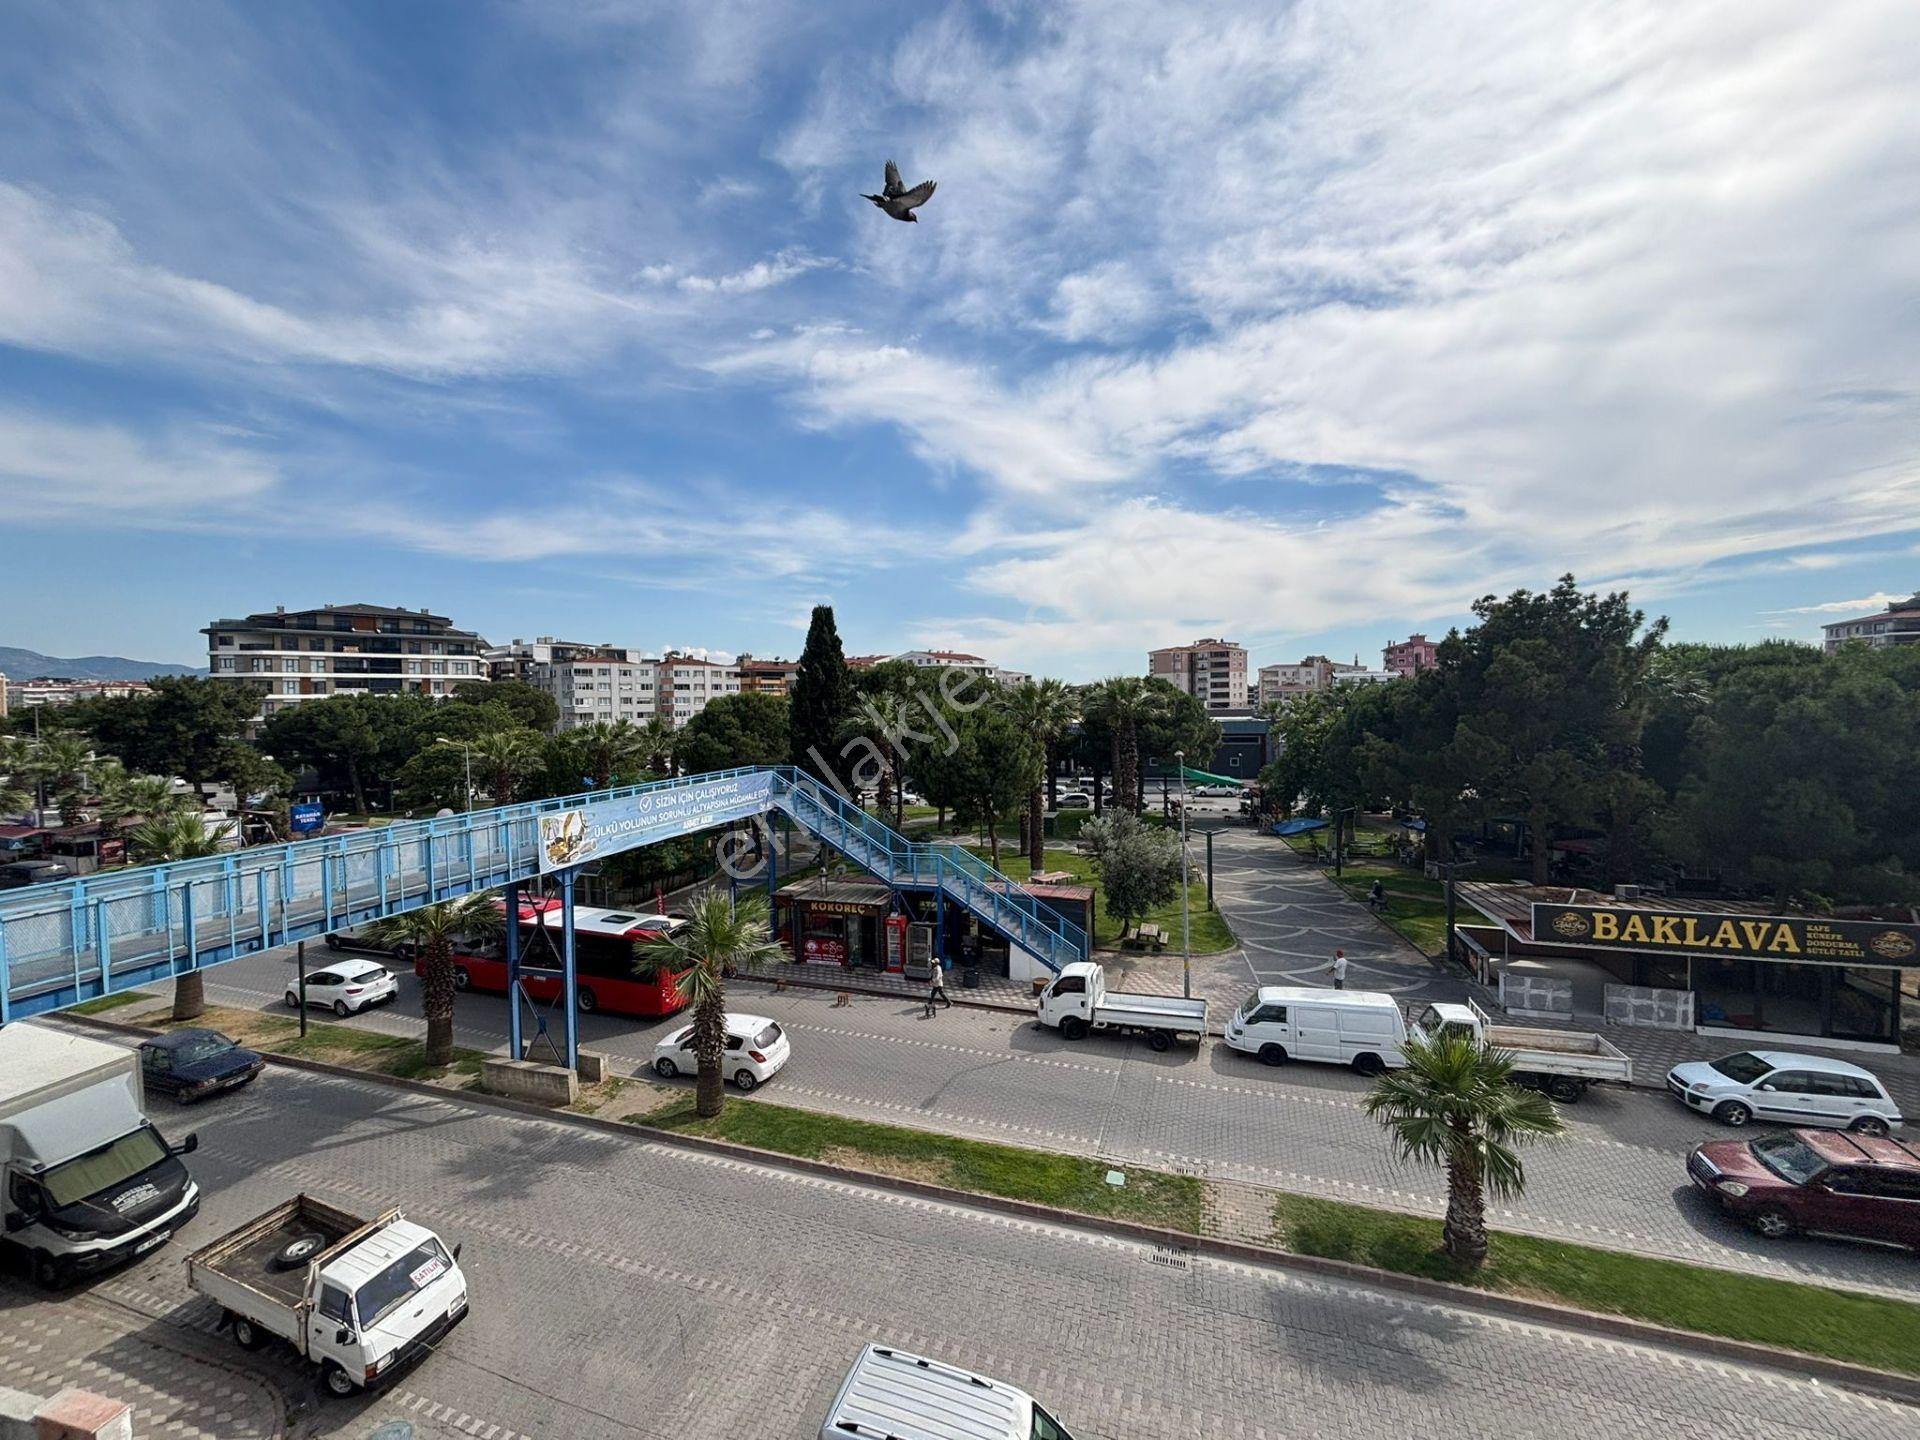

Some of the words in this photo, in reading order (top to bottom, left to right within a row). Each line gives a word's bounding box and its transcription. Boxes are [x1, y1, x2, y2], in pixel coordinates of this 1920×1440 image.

[656, 794, 677, 809] SİZİN
[678, 789, 694, 806] İÇİN
[695, 783, 738, 800] ÇALIŞIYORUZ
[594, 820, 618, 838] ÜLKÜ
[619, 814, 657, 832] YOLUNUN
[658, 808, 691, 823] SORUNLU
[810, 901, 866, 915] KOKOREÇ
[1592, 911, 1801, 953] BAKLAVA
[1806, 925, 1831, 933] KAFE
[1806, 931, 1843, 941] KÜNEFE
[1806, 939, 1860, 950] DONDURMA
[1806, 947, 1836, 956] SÜTLÜ
[1839, 948, 1866, 958] TATLI
[413, 1260, 441, 1282] SATILIK
